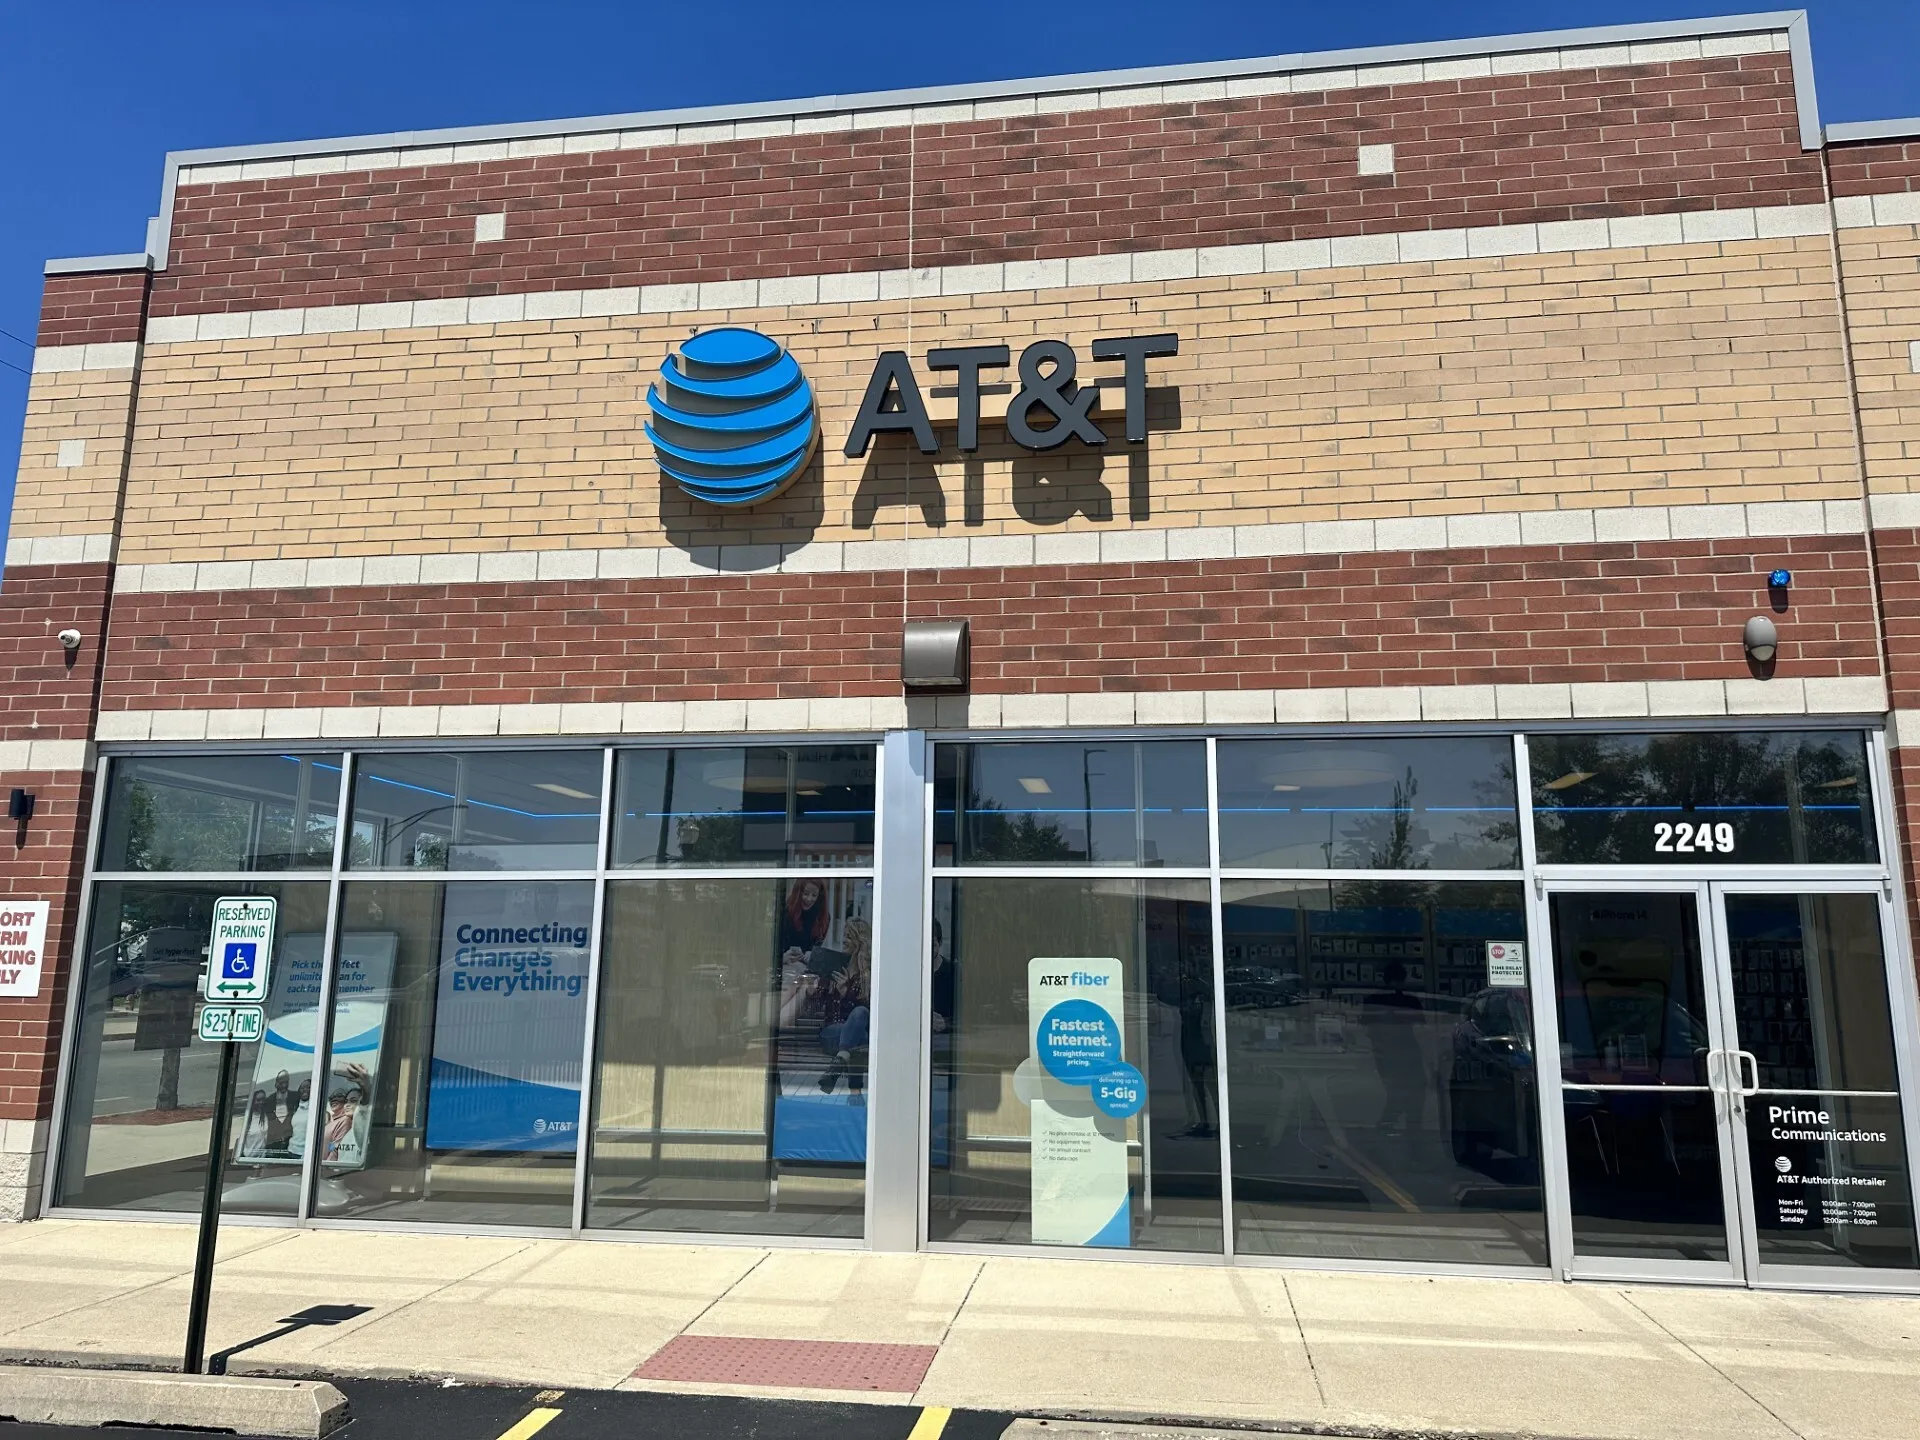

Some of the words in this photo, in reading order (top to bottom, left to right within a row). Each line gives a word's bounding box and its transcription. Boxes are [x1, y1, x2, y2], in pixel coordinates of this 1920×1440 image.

[843, 333, 1178, 457] AT&T
[1654, 822, 1735, 853] 2249
[0, 911, 36, 927] ORT
[218, 907, 271, 921] RESERVED
[0, 931, 28, 946] RM
[219, 925, 266, 938] PARKING
[456, 922, 588, 948] Connecting
[0, 950, 36, 966] KING
[291, 960, 310, 969] Pick
[311, 960, 323, 969] th
[454, 947, 553, 973] Changes
[0, 969, 21, 985] LY
[289, 971, 322, 981] unlimite
[351, 971, 366, 981] for
[1039, 975, 1069, 986] AT&T
[1070, 971, 1110, 986] fiber
[286, 984, 305, 993] each
[204, 1011, 235, 1033] $250
[236, 1013, 259, 1033] FINE
[1051, 1018, 1105, 1032] Fastest
[1048, 1033, 1112, 1047] Internet.
[1052, 1049, 1105, 1058] Straightforward
[1066, 1058, 1091, 1066] pricing.
[1098, 1076, 1124, 1085] delivering
[1101, 1086, 1137, 1102] 5-Gig
[1768, 1105, 1830, 1124] Prime
[547, 1121, 573, 1131] AT&T
[1771, 1127, 1887, 1143] Communications
[336, 1143, 356, 1151] AT&T
[1776, 1175, 1800, 1184] AT&T
[1801, 1175, 1850, 1186] Authorized
[1851, 1177, 1887, 1186] Retailer
[1778, 1198, 1804, 1206] Mon-Fri
[1779, 1207, 1808, 1215] Saturday
[1853, 1209, 1877, 1217] 7:00pm
[1780, 1216, 1804, 1224] Sunday
